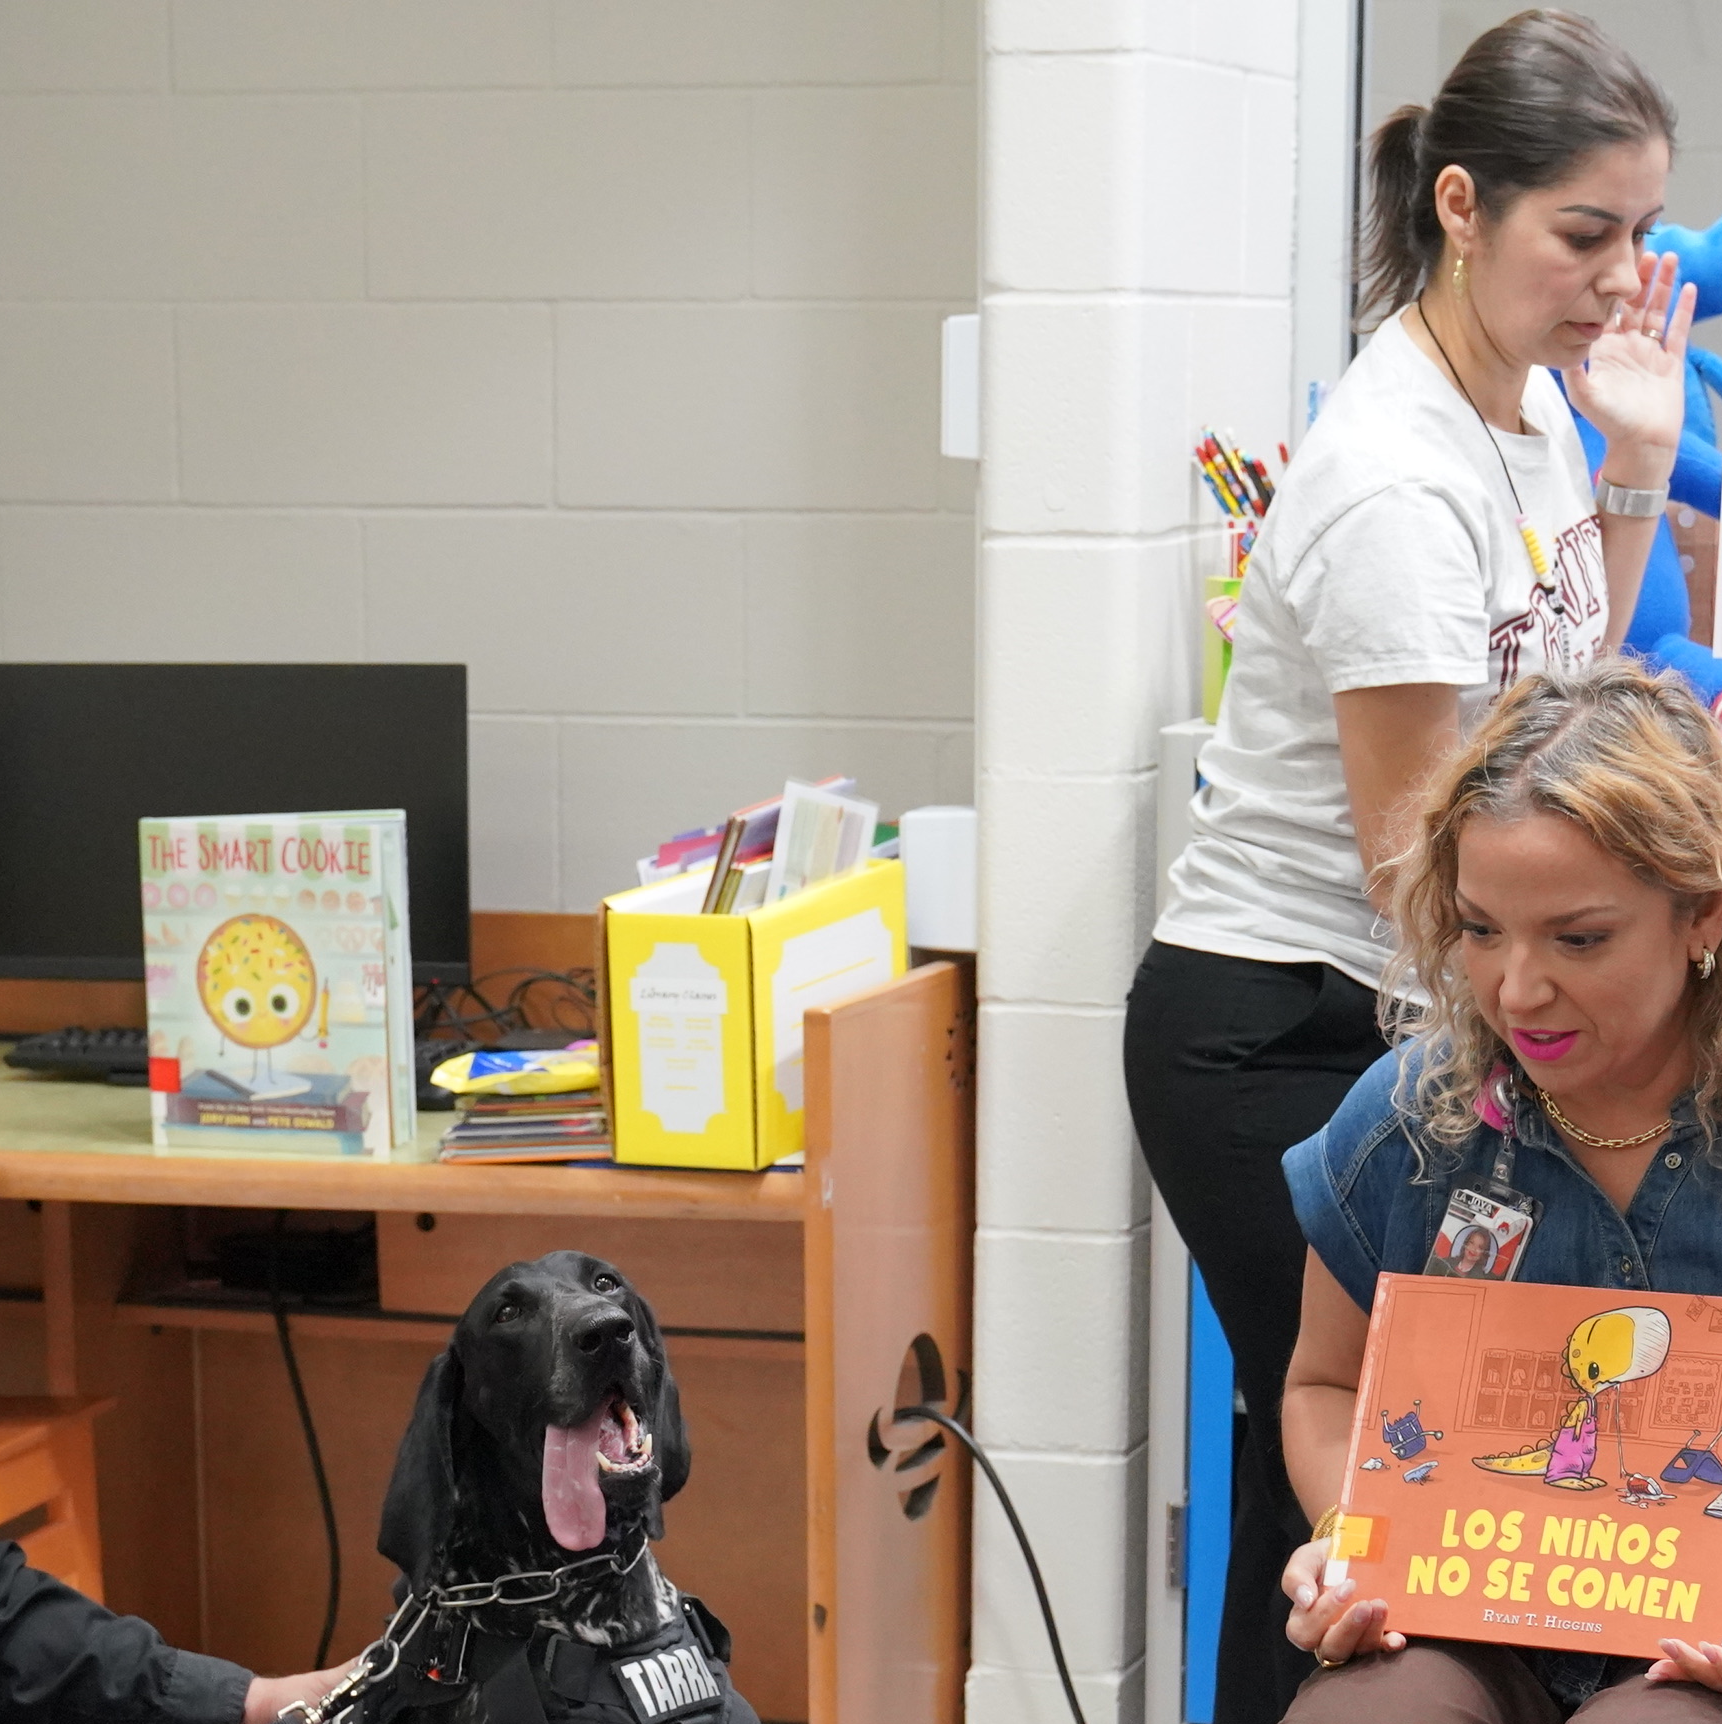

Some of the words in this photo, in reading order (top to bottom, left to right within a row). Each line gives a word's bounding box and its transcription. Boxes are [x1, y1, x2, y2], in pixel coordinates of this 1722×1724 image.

[148, 834, 189, 872] THE
[197, 834, 272, 874] SMART
[280, 836, 371, 875] COOKIE
[1454, 1190, 1467, 1202] LA
[1467, 1196, 1494, 1214] JOYA
[1441, 1508, 1525, 1553] LOS
[1406, 1554, 1471, 1598] NO
[1482, 1557, 1535, 1602] SE
[1546, 1563, 1701, 1623] COMEN
[1525, 1613, 1539, 1627] T.
[620, 1644, 721, 1718] TARRA
